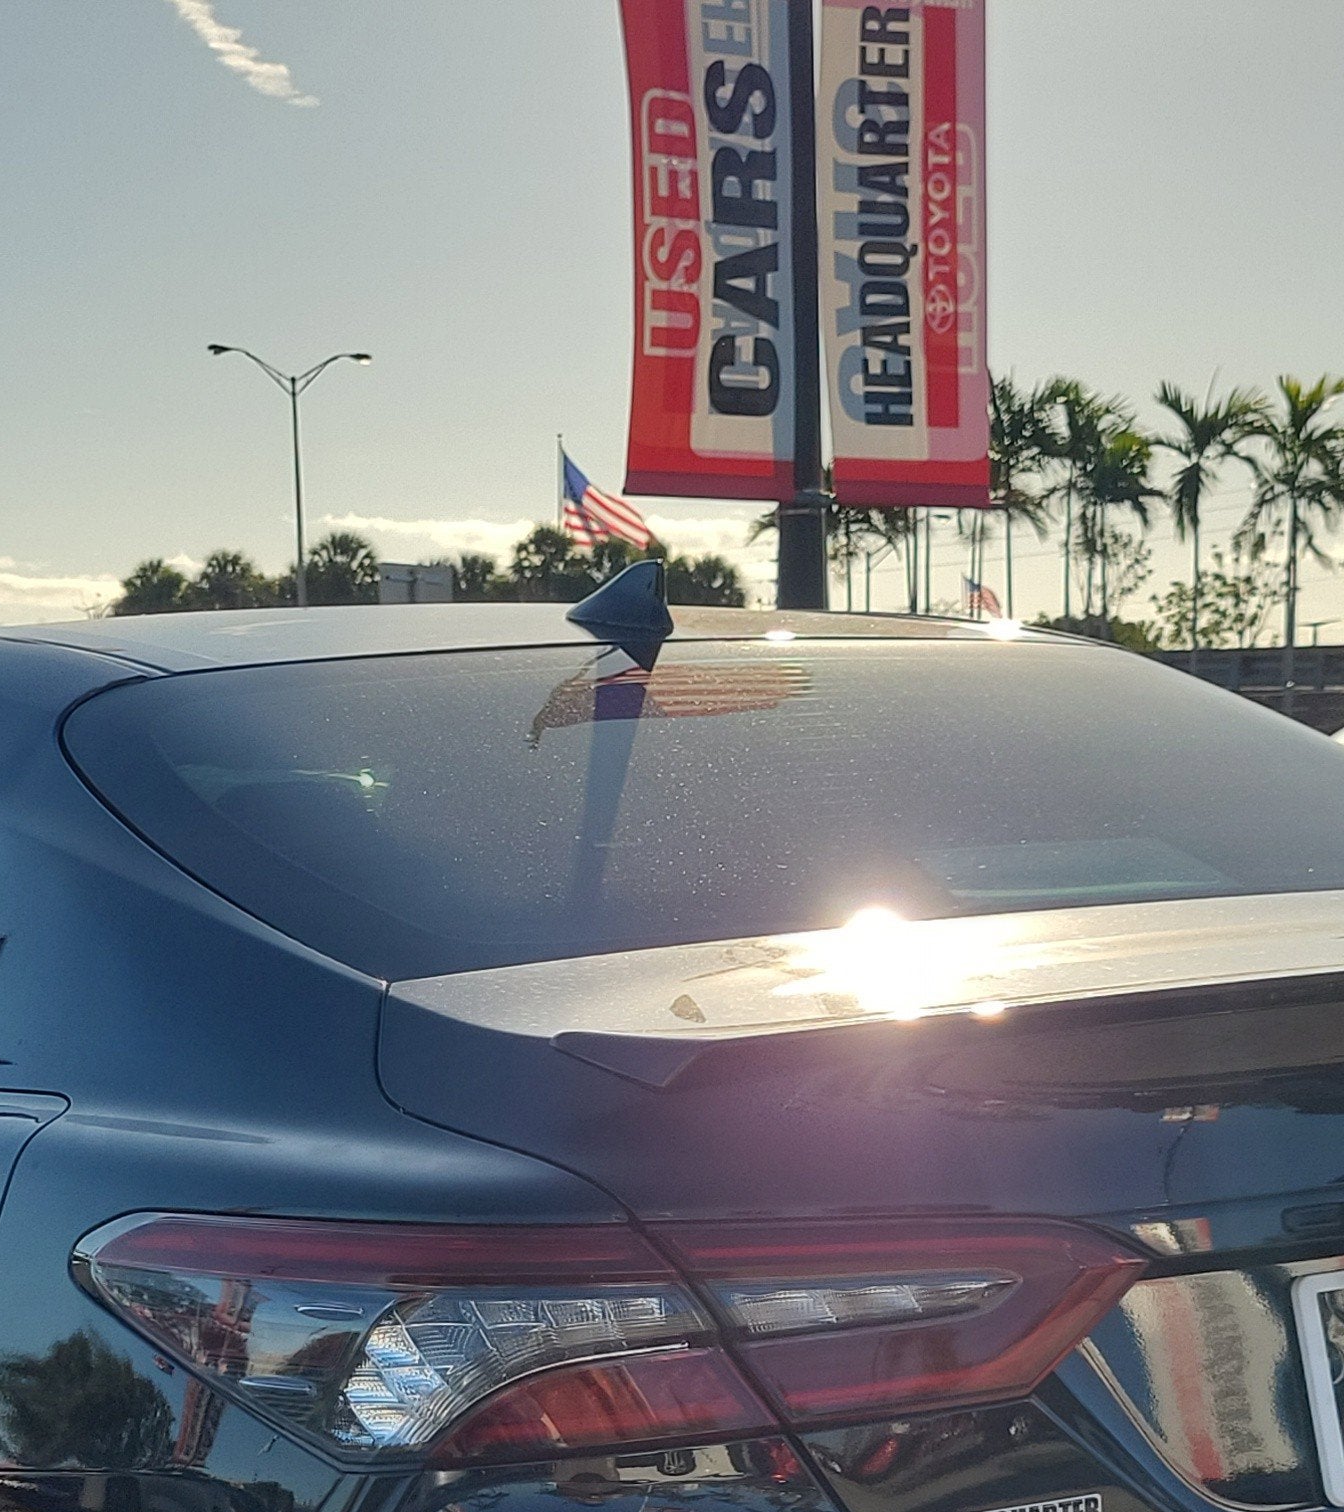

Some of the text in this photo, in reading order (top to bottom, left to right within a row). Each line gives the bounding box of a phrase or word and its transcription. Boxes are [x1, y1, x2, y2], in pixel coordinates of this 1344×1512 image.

[642, 88, 702, 357] USED
[704, 59, 779, 416] CARS
[858, 5, 918, 427] HEADQUARTER
[927, 122, 953, 279] TOYOTA
